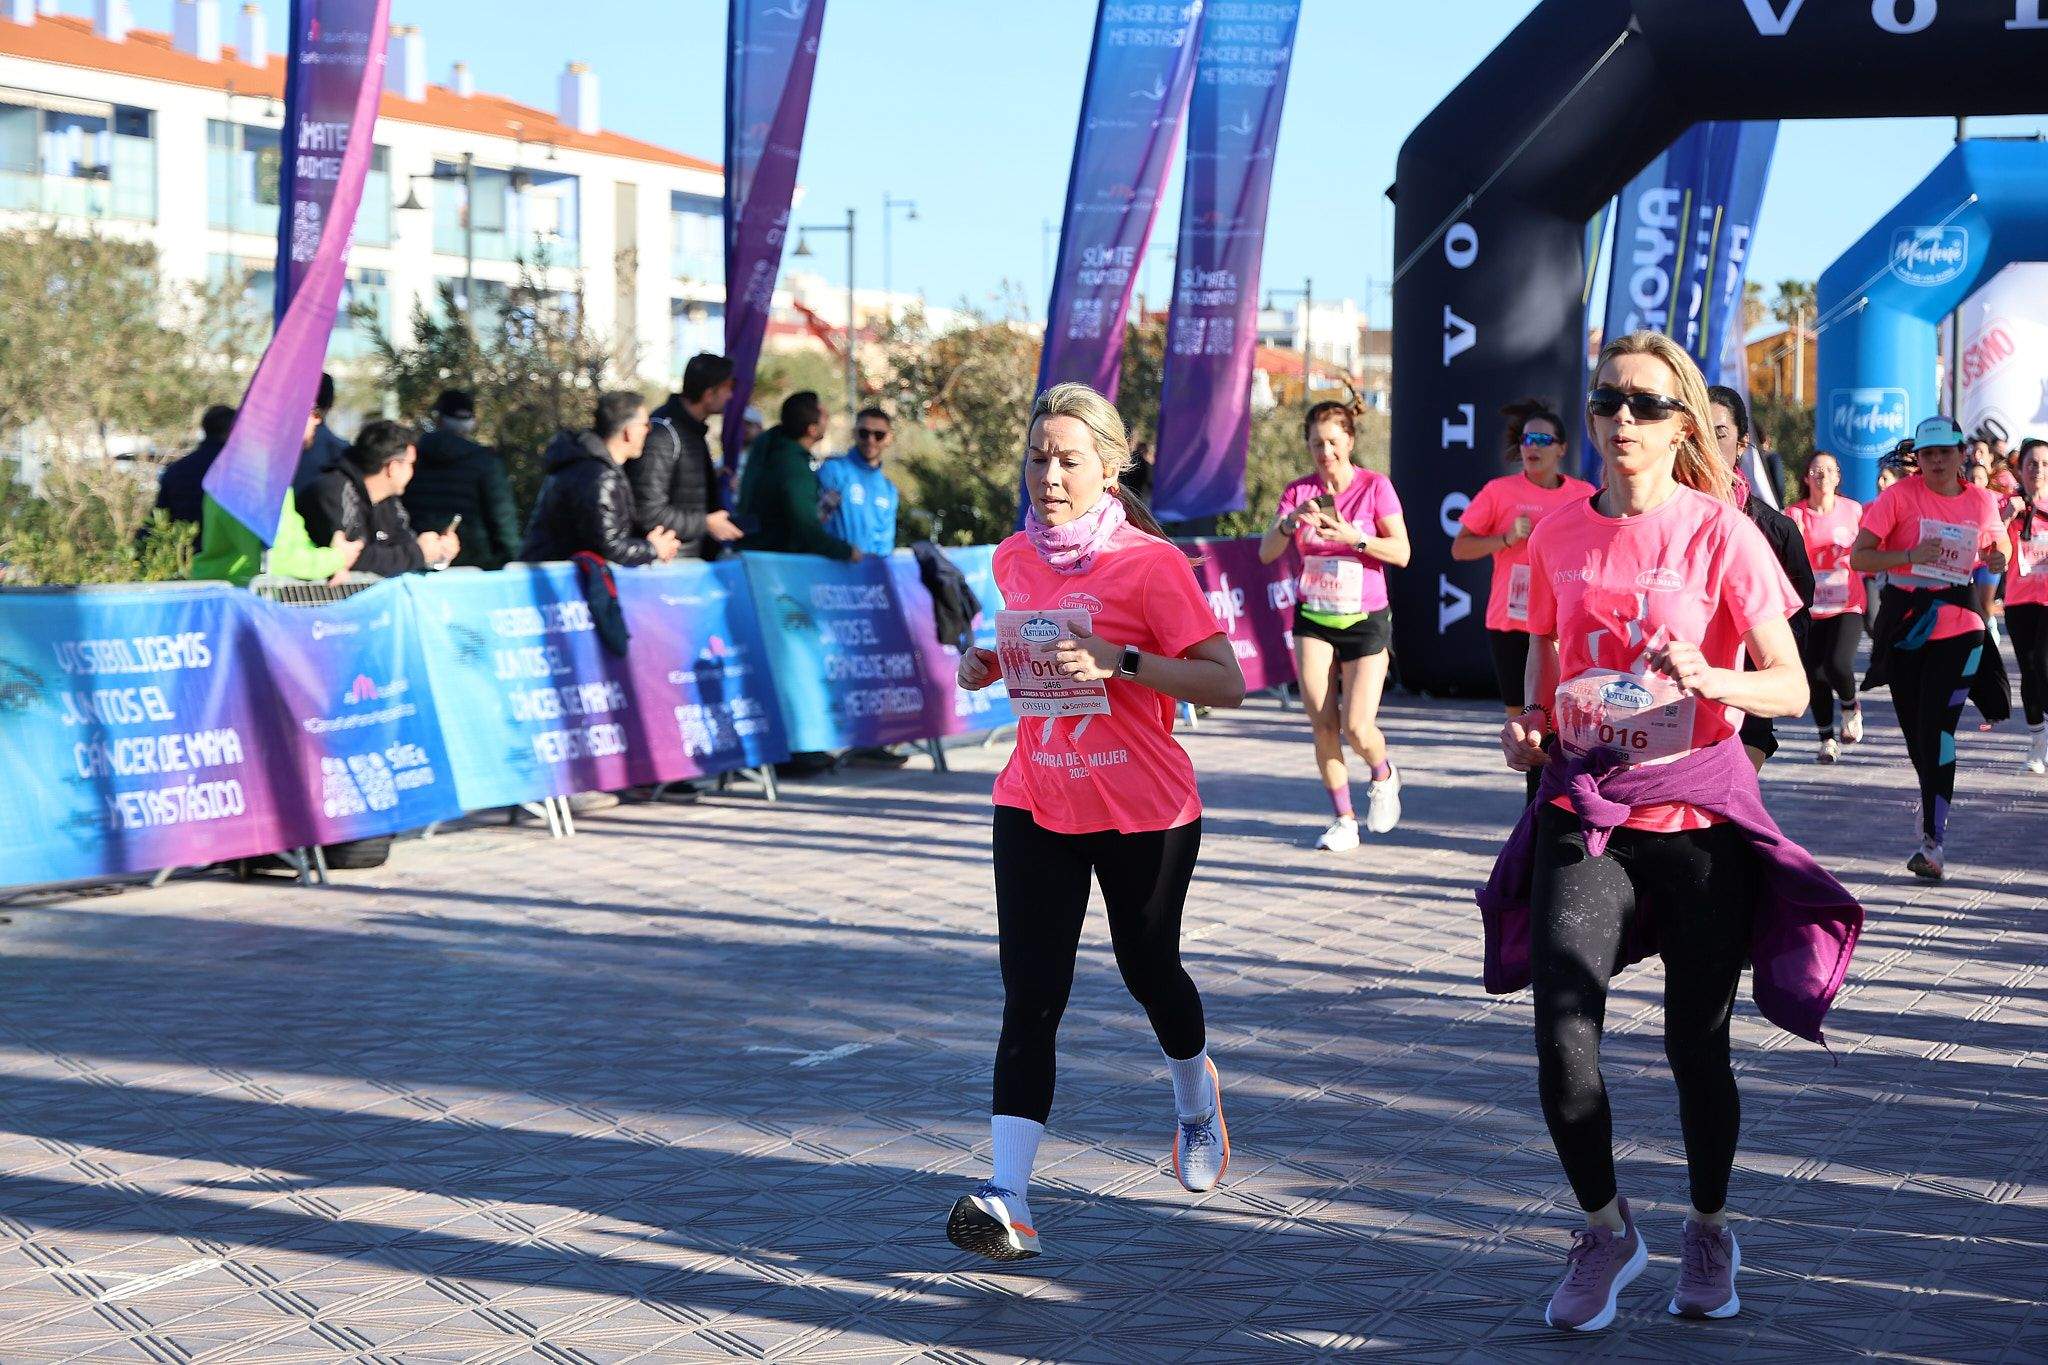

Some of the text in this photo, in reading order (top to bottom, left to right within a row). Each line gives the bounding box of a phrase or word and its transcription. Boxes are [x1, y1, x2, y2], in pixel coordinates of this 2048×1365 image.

[1439, 221, 1479, 634] VOLVO
[1553, 568, 1594, 585] OYSHO
[1061, 598, 1100, 612] ASTURIANA
[1023, 627, 1058, 637] ASTURIANA
[1603, 688, 1649, 705] ASTURIANA
[61, 685, 176, 728] JUNTOS EL
[1022, 702, 1101, 711] OYSHO Santander
[1599, 724, 1648, 750] 016
[73, 726, 245, 779] CÁNCER DE MAMA
[1087, 749, 1128, 768] MUJER
[107, 775, 246, 830] METASTÁSICO
